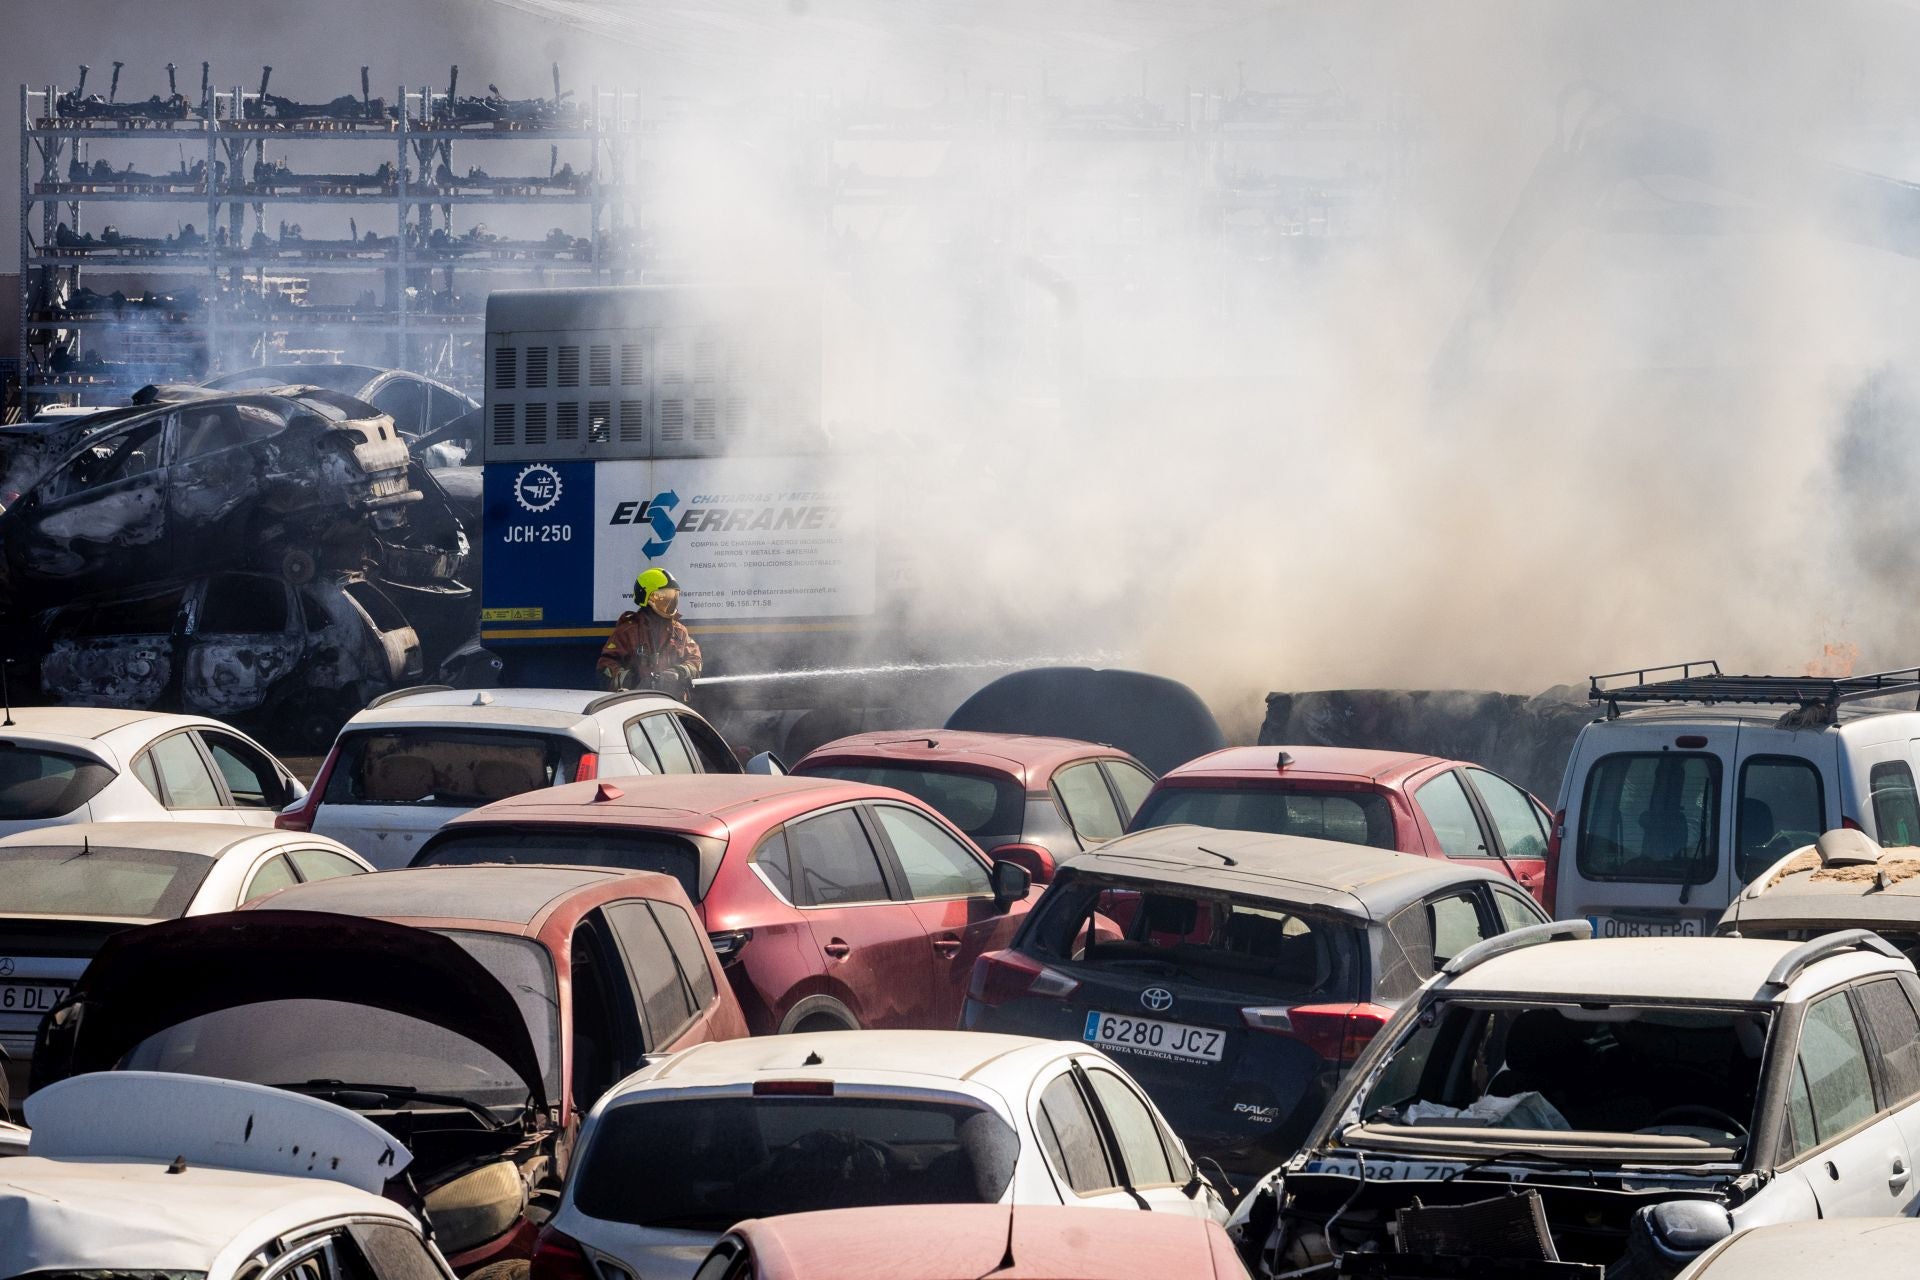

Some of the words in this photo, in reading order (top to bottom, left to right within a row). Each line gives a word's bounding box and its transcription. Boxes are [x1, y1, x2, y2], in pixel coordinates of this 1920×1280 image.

[691, 493, 774, 504] CHATARRAS
[786, 490, 852, 502] METAL
[609, 501, 652, 525] EL
[750, 548, 781, 556] METALES
[1604, 919, 1652, 938] 0083
[1102, 1017, 1164, 1047] 6280
[1170, 1028, 1219, 1056] JCZ
[1101, 1043, 1131, 1054] TOYOTA
[1133, 1048, 1172, 1060] VALENCIA
[1233, 1102, 1279, 1118] RAV4
[1248, 1115, 1273, 1124] AWD
